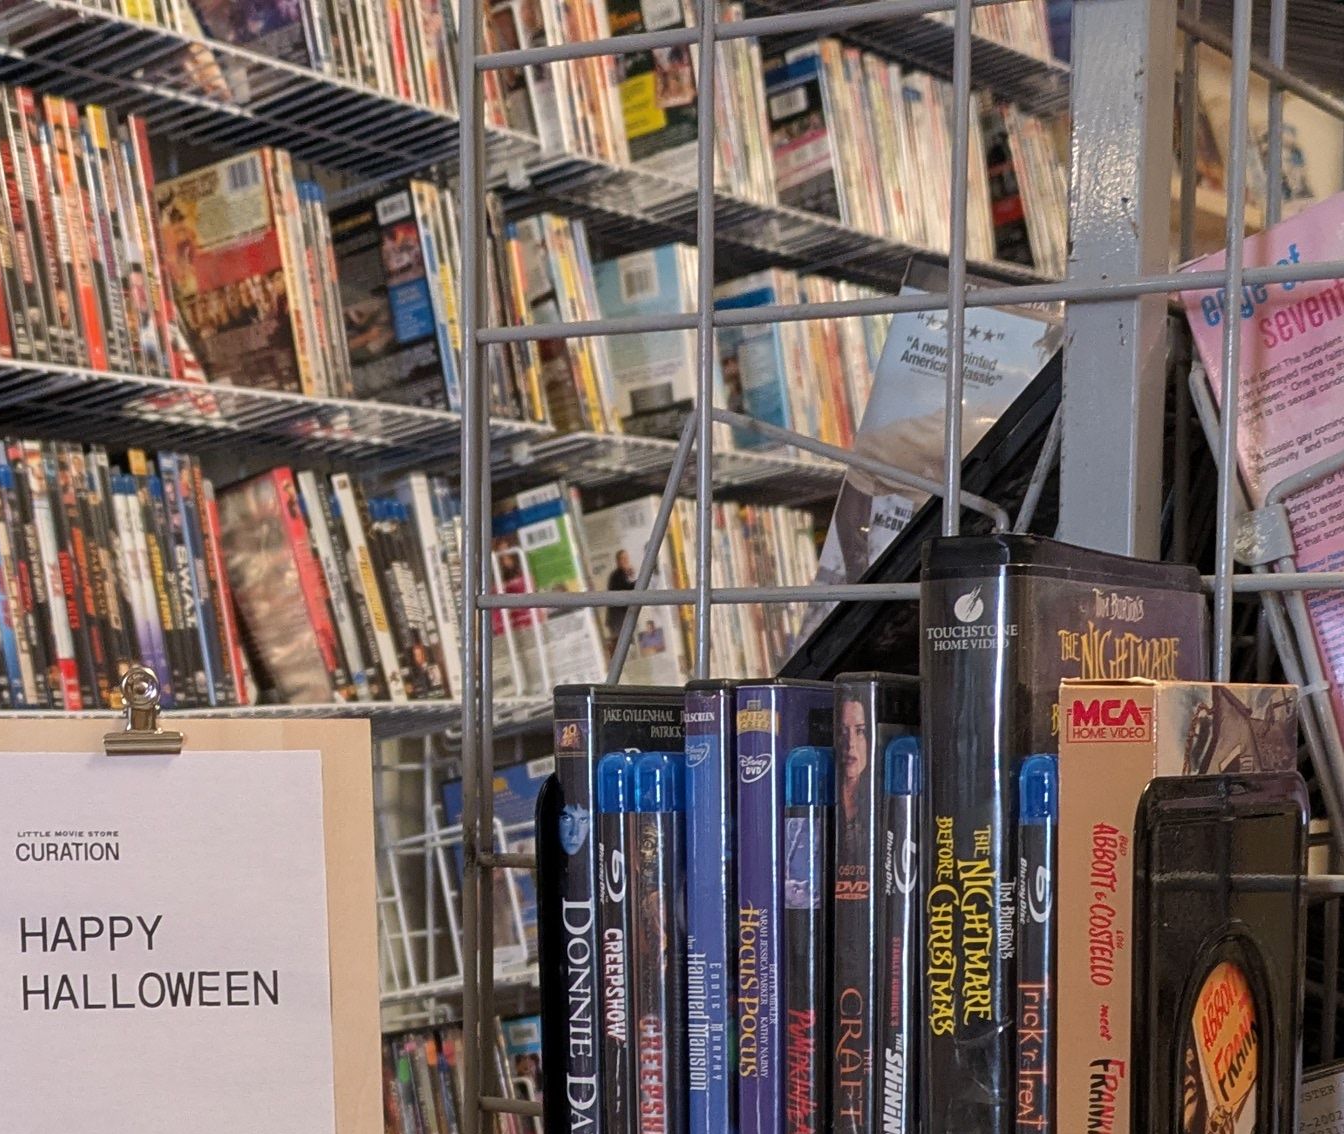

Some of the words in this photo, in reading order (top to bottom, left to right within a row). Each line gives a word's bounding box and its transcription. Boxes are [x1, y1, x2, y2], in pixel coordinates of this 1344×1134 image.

[926, 624, 1018, 640] TOUCHSTONE
[934, 639, 967, 650] HOME
[968, 638, 1009, 650] VIDEO
[1058, 629, 1080, 662] THE
[1081, 621, 1180, 680] NIGHTMARE
[602, 708, 620, 725] JAKE
[622, 708, 674, 723] GYLLENHAAL
[1072, 699, 1145, 726] MCA
[651, 725, 682, 739] PATRICK
[1073, 727, 1108, 739] HOME
[745, 767, 763, 775] DVD
[15, 842, 120, 861] CURATION
[55, 830, 84, 838] MOVIE
[88, 830, 119, 838] STORE
[934, 815, 954, 883] BEFORE
[973, 824, 992, 856] THE
[1090, 821, 1120, 892] ABBOTT
[835, 880, 870, 893] DVD
[998, 879, 1017, 903] TIM
[20, 915, 163, 953] HAPPY
[958, 859, 997, 1027] NIGHTMARE
[997, 904, 1017, 960] BURTON'S
[1087, 901, 1116, 987] COSTELLO
[562, 899, 596, 1059] DONNIE
[927, 884, 959, 1036] CHRISTMAS
[22, 970, 279, 1011] HALLOWEEN
[603, 928, 626, 1040] CREEPSHOW
[687, 952, 708, 1020] Haunted
[1098, 1004, 1113, 1041] meet
[688, 1023, 710, 1092] Mansion
[836, 988, 864, 1127] CRAFT
